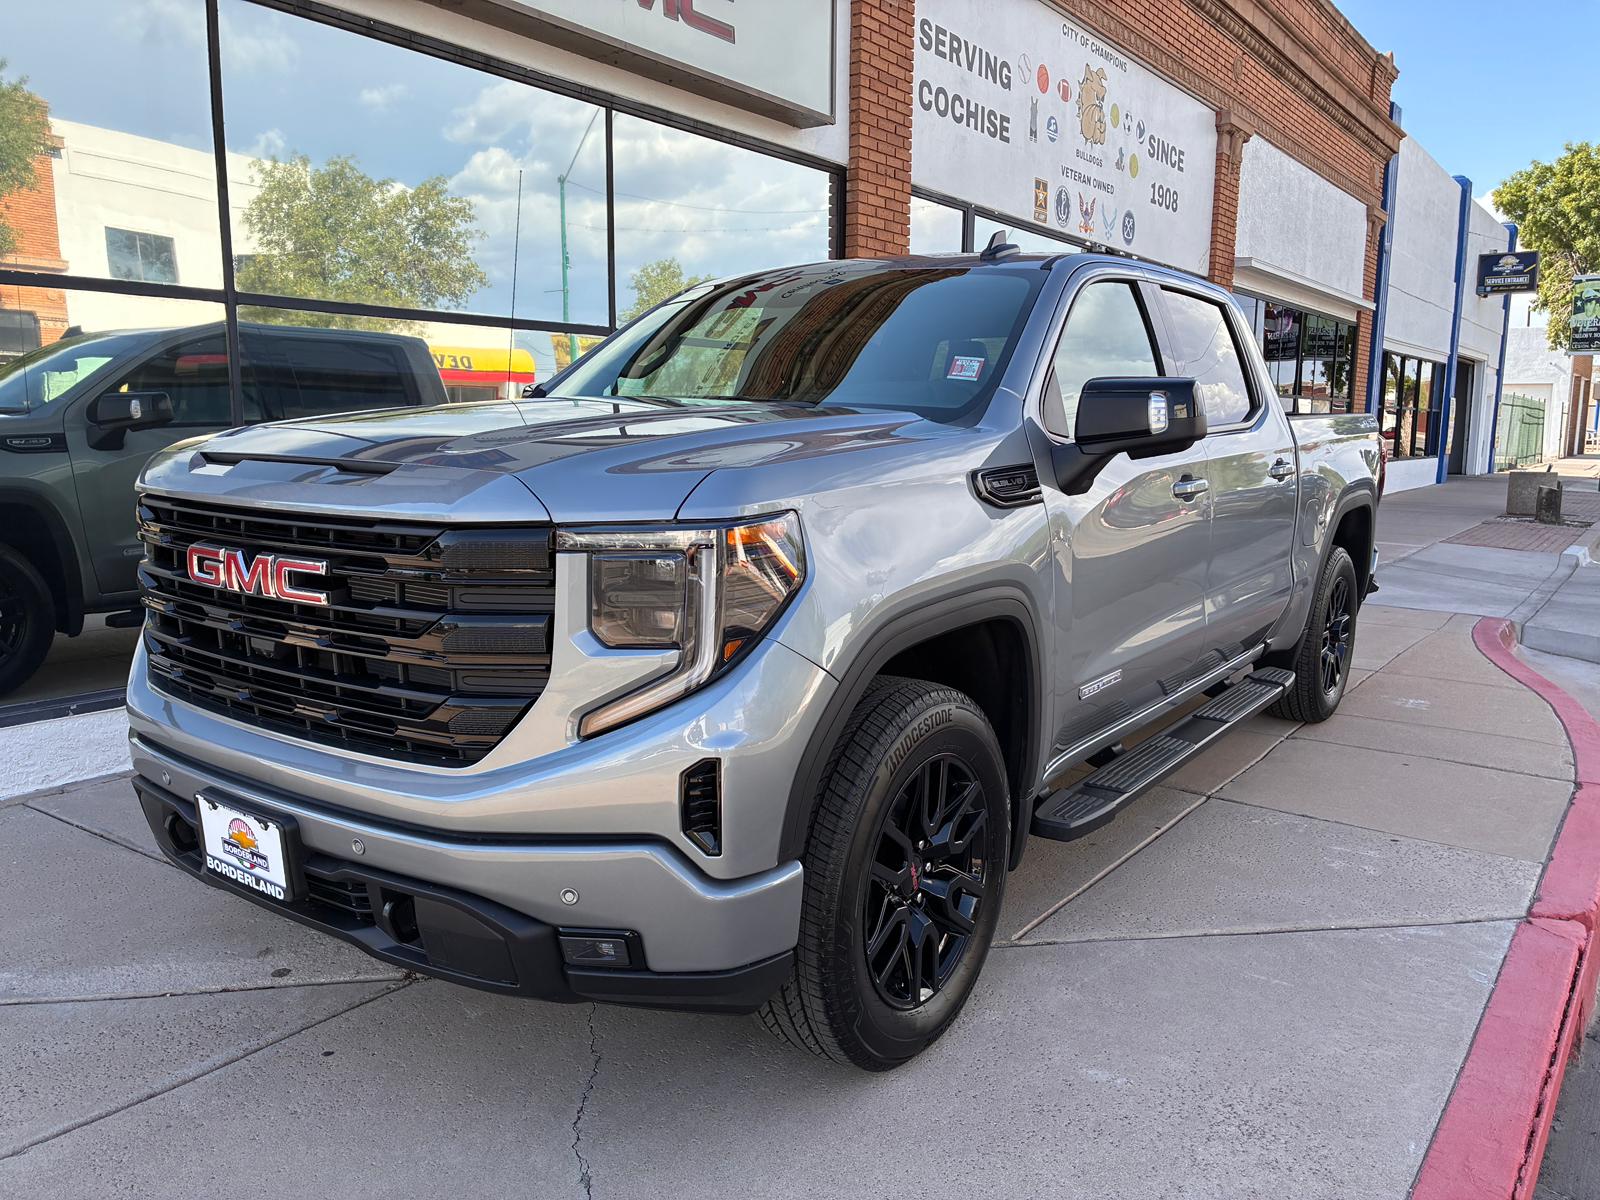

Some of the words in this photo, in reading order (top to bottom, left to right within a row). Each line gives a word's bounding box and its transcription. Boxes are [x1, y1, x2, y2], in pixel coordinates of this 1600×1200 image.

[918, 18, 1012, 91] SERVING
[1062, 23, 1079, 42] CITY
[1080, 35, 1090, 48] OF
[1090, 41, 1128, 73] CHAMPIONS
[917, 79, 1011, 144] COCHISE
[1075, 148, 1103, 168] BULLDOGS
[1147, 134, 1185, 173] SINCE
[1061, 164, 1092, 187] VETERAN
[1092, 178, 1115, 195] OWNED
[1149, 182, 1178, 213] 1908
[187, 544, 328, 606] GMC
[885, 708, 953, 777] BRIDGESTONE
[206, 855, 284, 900] BORDERLAND
[224, 843, 268, 868] BORDERLAND
